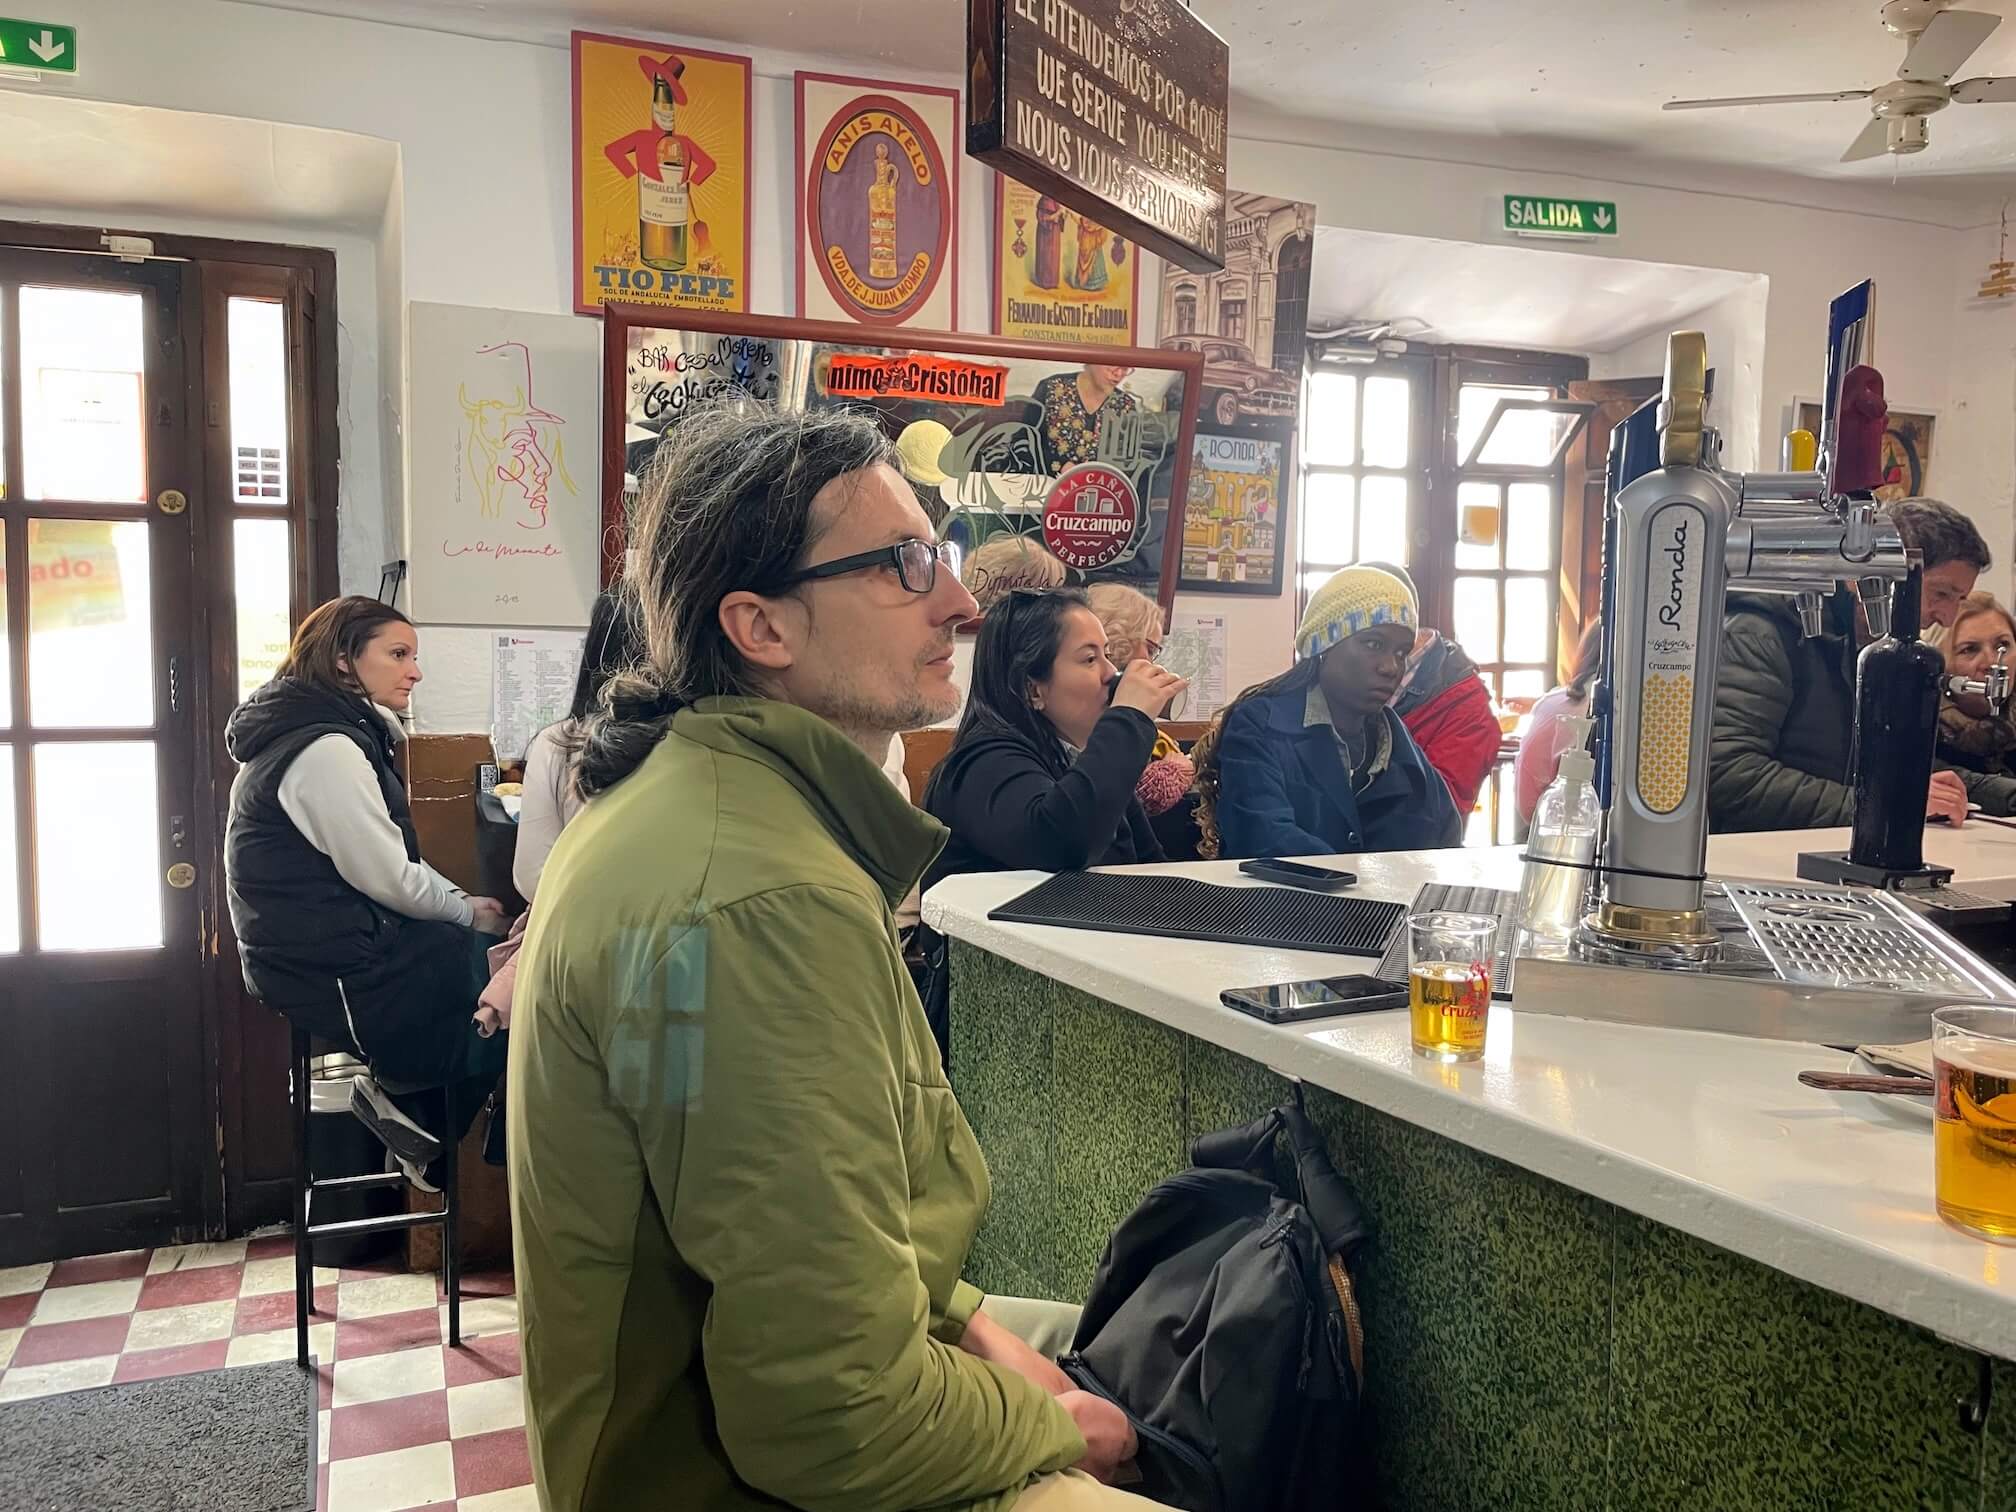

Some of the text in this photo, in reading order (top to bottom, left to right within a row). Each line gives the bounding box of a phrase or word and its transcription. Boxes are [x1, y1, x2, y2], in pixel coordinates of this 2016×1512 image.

[1044, 0, 1151, 103] ATENDEMOS
[1155, 71, 1185, 130] POR
[1037, 48, 1067, 108] WE
[1071, 71, 1127, 146] SERVE
[1136, 114, 1168, 170] YOU
[831, 116, 928, 178] ANIS AYELO
[1016, 99, 1072, 172] NOUS
[1077, 135, 1124, 200] VOUS
[1127, 166, 1198, 239] SERVONS
[1509, 199, 1583, 228] SALIDA
[593, 266, 734, 299] TIO PEPE
[631, 290, 670, 300] ANDALUCIA
[674, 294, 725, 305] EMBOTELLADO
[869, 290, 899, 306] JUAN
[897, 258, 927, 299] MOMPO
[1008, 298, 1046, 325] FERNANDO
[637, 345, 670, 373] BAR
[908, 363, 1003, 400] Cristóbal
[1058, 473, 1125, 500] LA CAÑA
[1046, 513, 1132, 535] Cruzcampo
[1050, 538, 1126, 567] PERFECTA
[1659, 520, 1688, 632] Ronda
[1648, 662, 1692, 672] Cruzcampo
